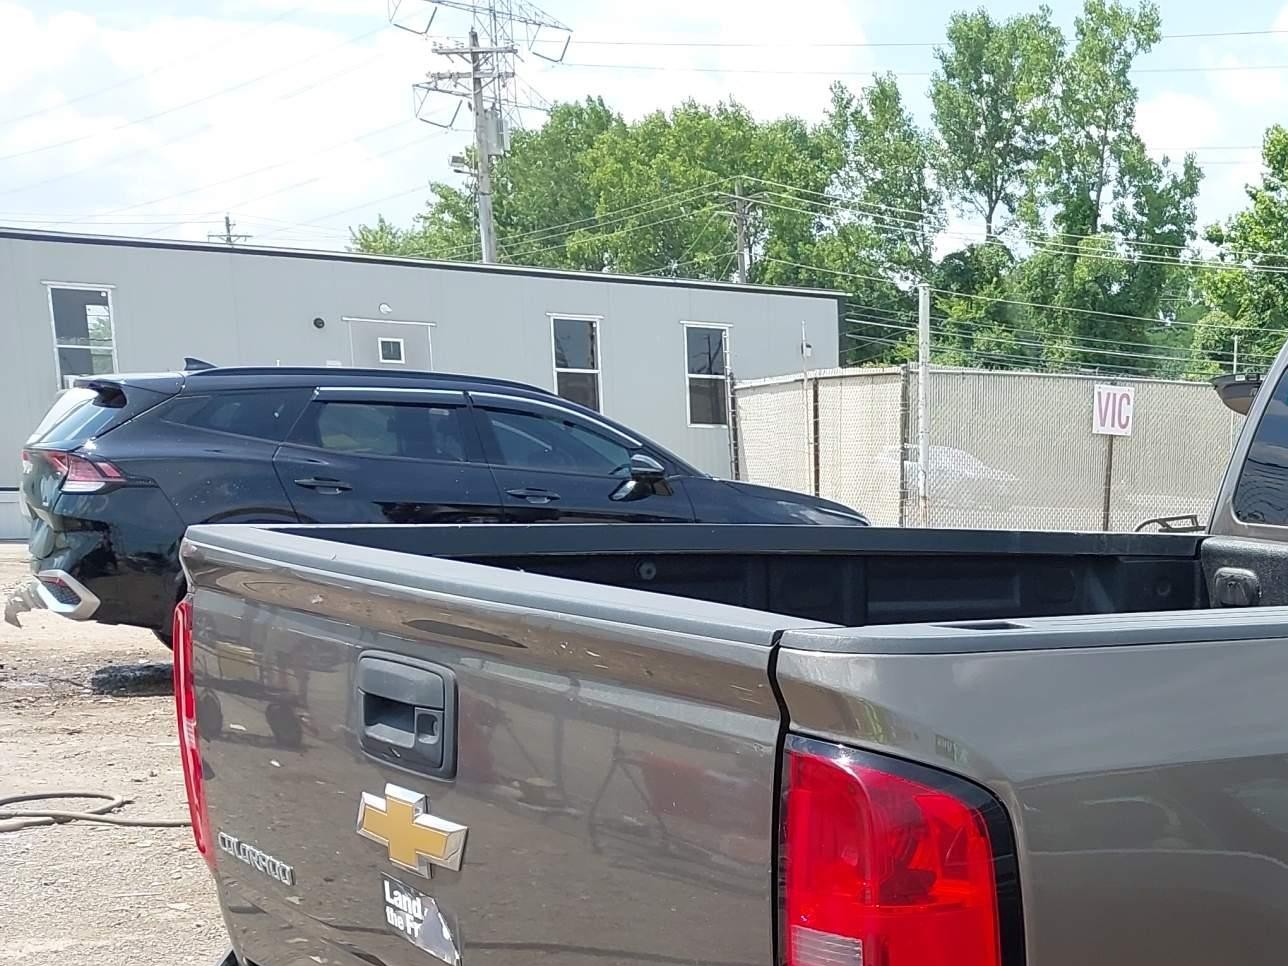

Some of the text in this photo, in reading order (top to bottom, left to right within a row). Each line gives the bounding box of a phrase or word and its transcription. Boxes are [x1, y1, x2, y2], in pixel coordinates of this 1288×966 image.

[1097, 391, 1131, 430] VIC
[218, 831, 294, 887] COLORADO
[383, 879, 424, 920] Land
[386, 905, 405, 931] the
